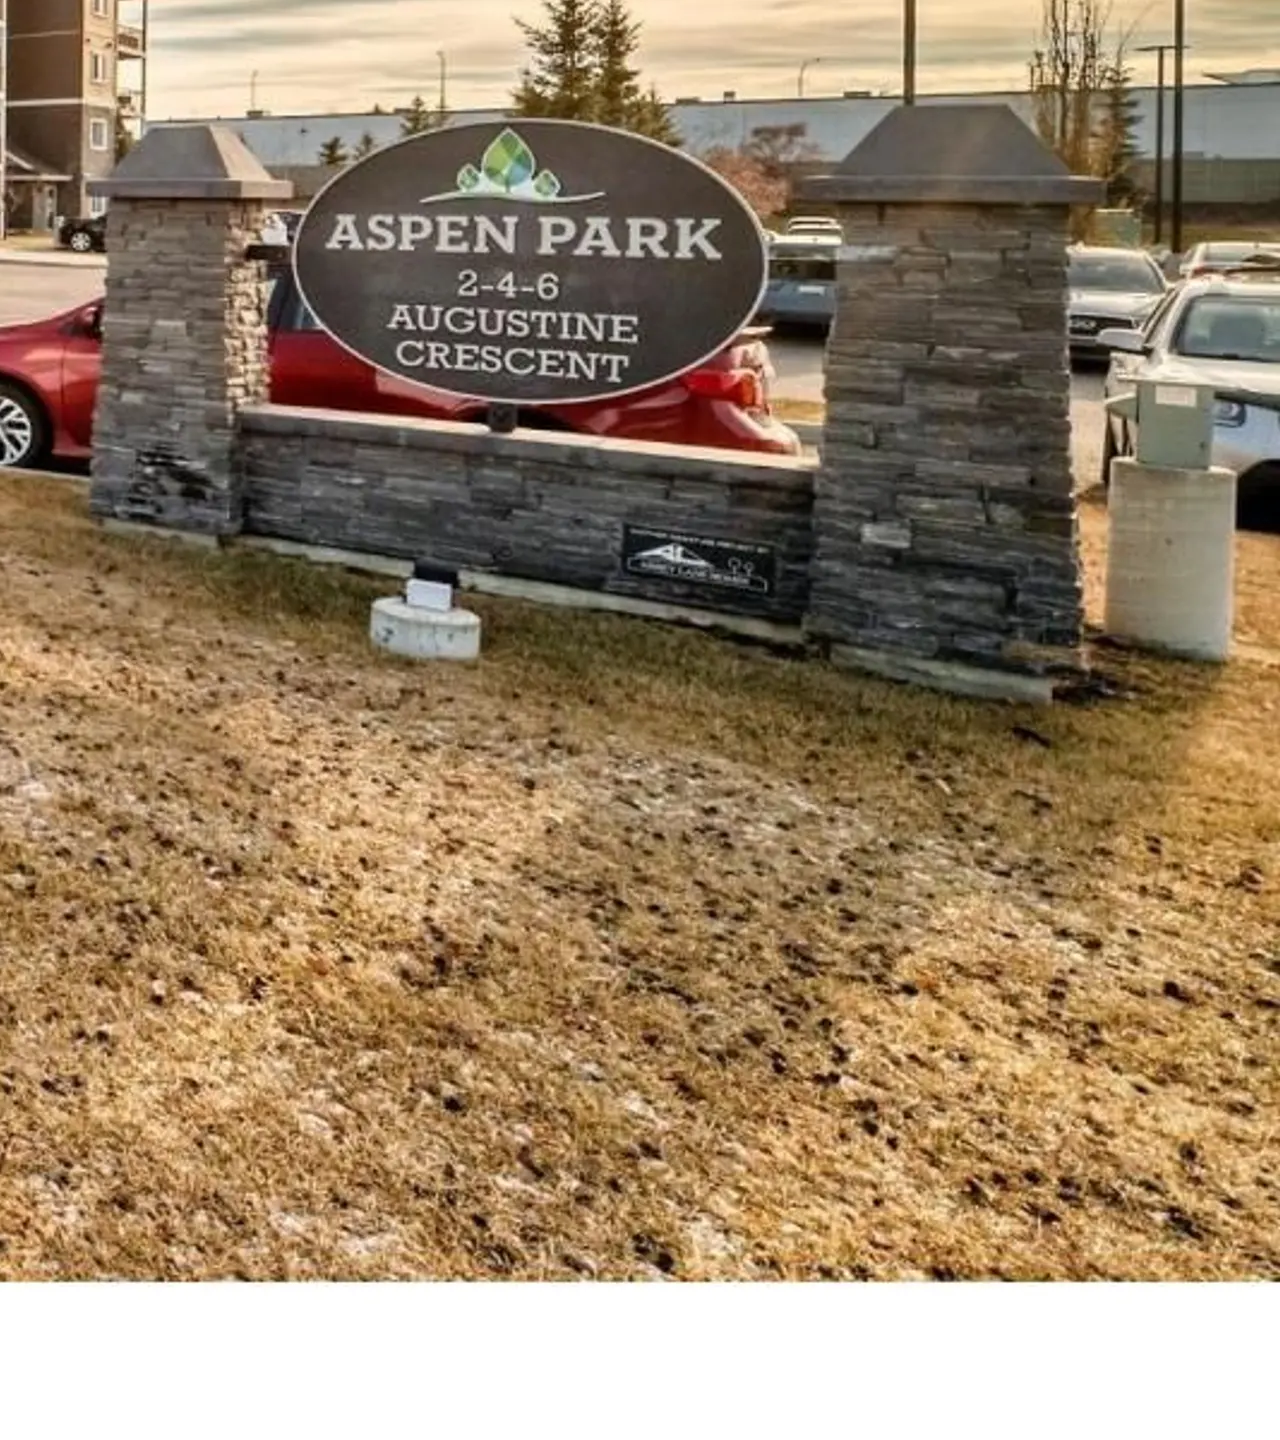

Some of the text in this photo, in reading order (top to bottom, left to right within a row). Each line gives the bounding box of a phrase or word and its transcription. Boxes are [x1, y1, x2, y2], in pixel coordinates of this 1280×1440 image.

[325, 213, 723, 260] ASPEN PARK
[457, 269, 560, 301] 2-4-6
[386, 304, 640, 344] AUGUSTINE
[395, 340, 630, 384] CRESCENT
